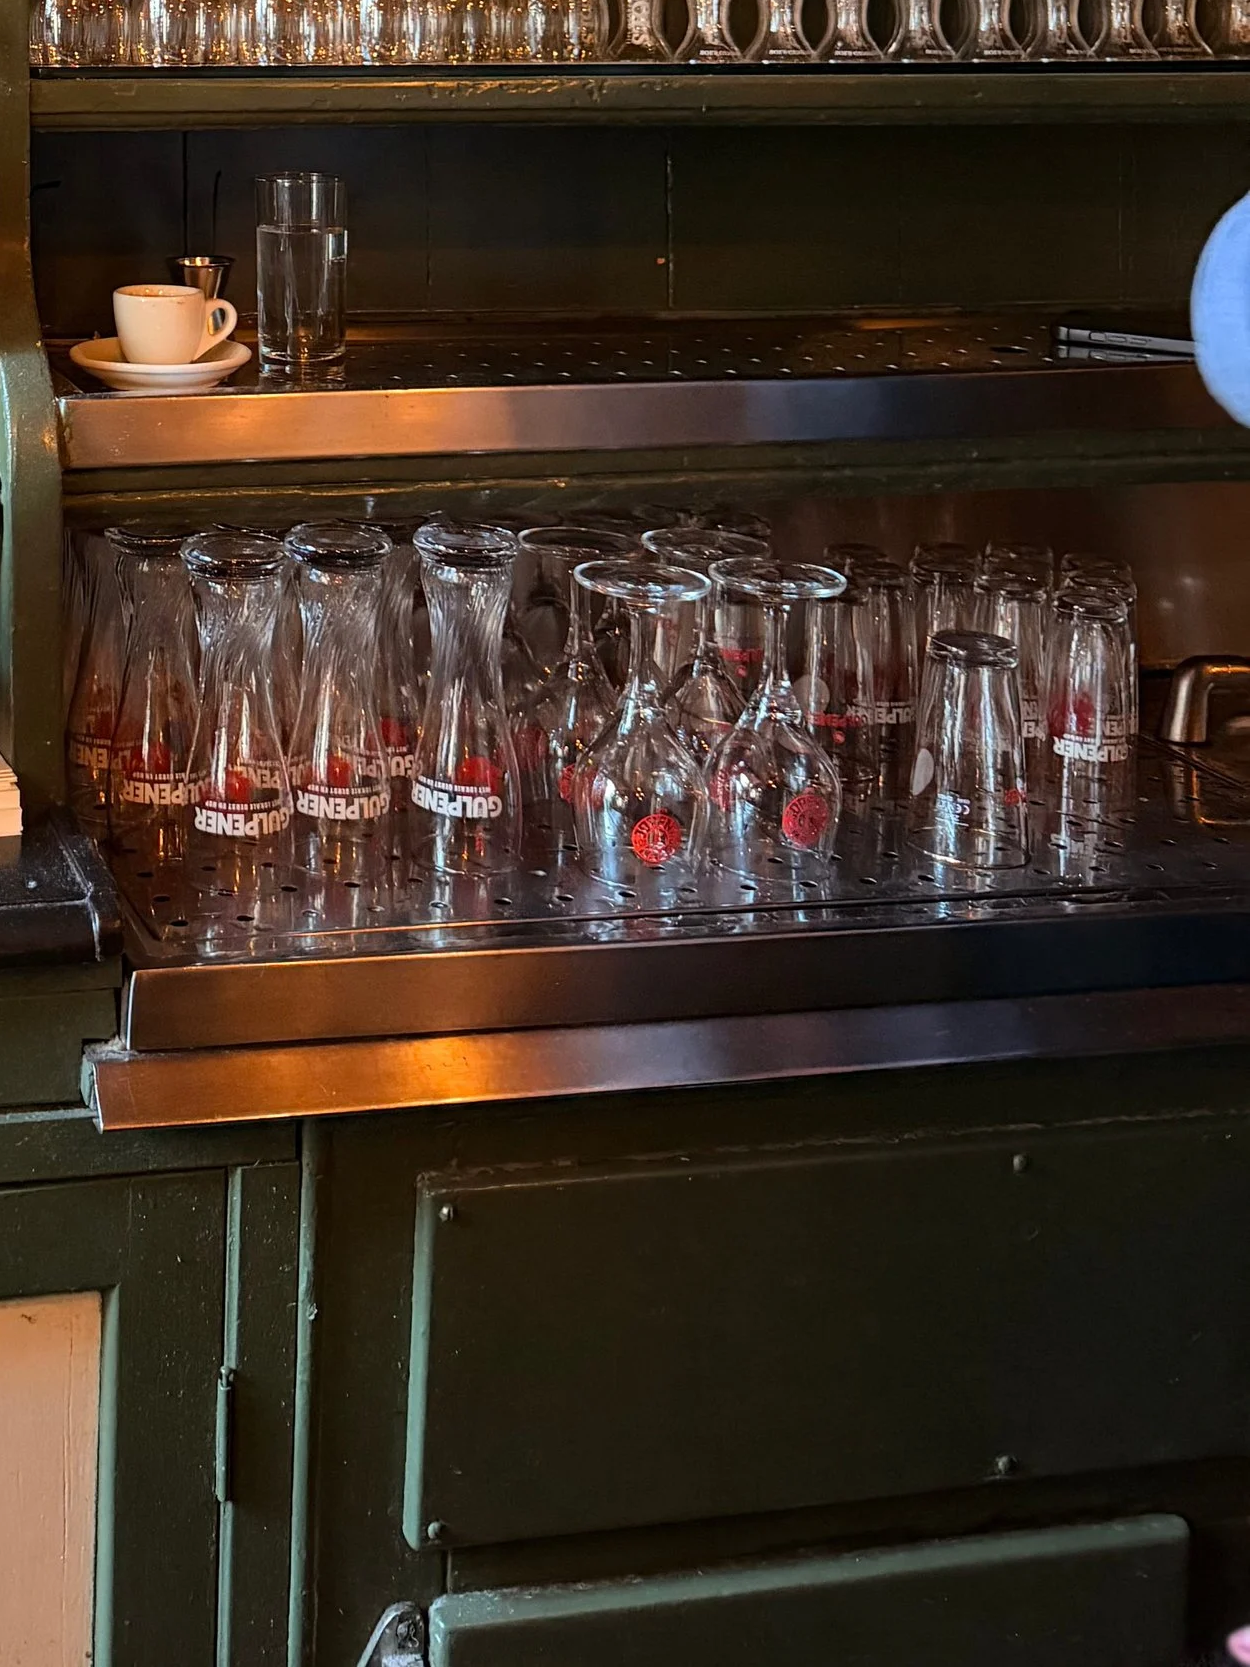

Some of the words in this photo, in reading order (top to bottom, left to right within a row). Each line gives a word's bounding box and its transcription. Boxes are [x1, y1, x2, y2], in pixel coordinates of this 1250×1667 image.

[296, 790, 390, 821] GULPENER
[412, 780, 502, 819] GULPENER
[194, 806, 290, 837] GULPENER
